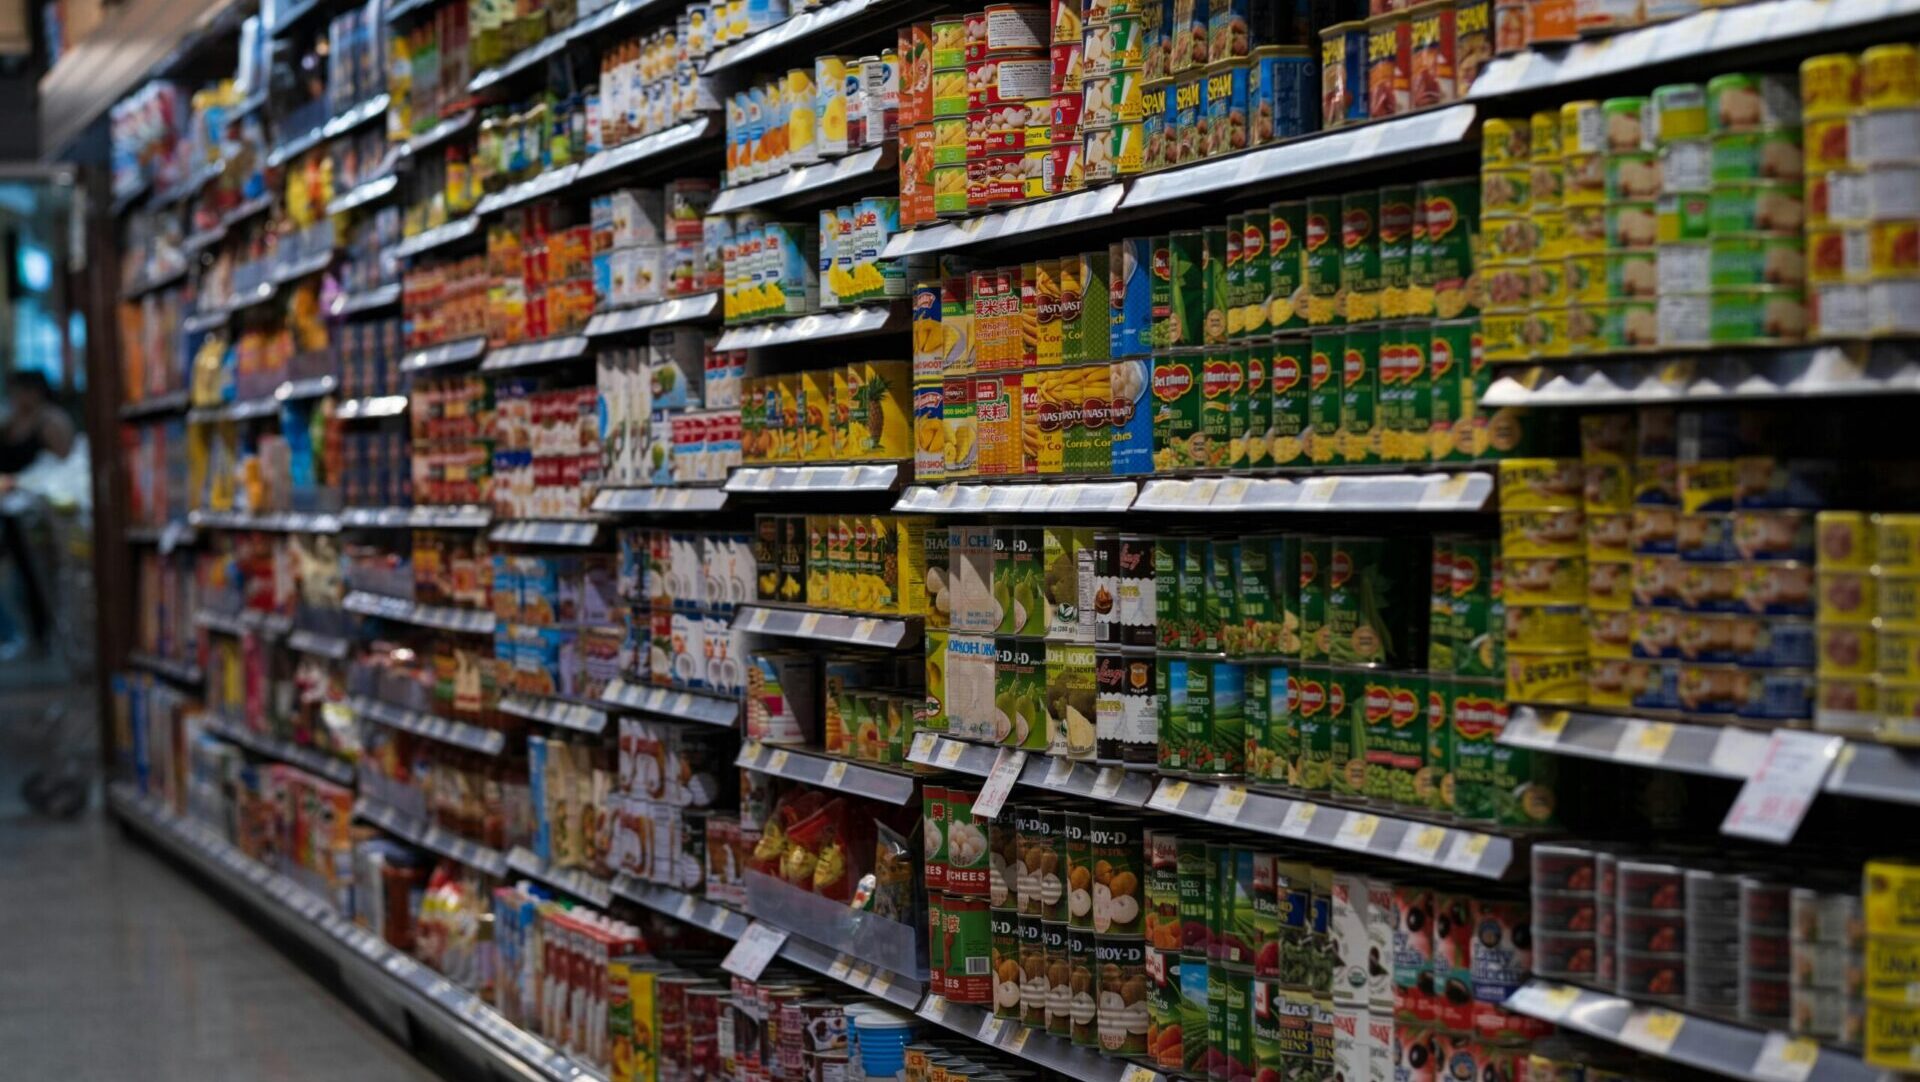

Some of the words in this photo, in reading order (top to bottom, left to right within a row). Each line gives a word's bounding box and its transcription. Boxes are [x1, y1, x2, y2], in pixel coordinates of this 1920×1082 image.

[1411, 15, 1441, 48] SPAM
[1457, 2, 1489, 34] SPAM
[1322, 35, 1346, 66] SPAM
[1368, 30, 1397, 62] SPAM
[1177, 83, 1199, 110] SPAM
[1208, 73, 1232, 101] SPAM
[1142, 90, 1166, 116] SPAM
[989, 185, 1019, 196] Chestnuts
